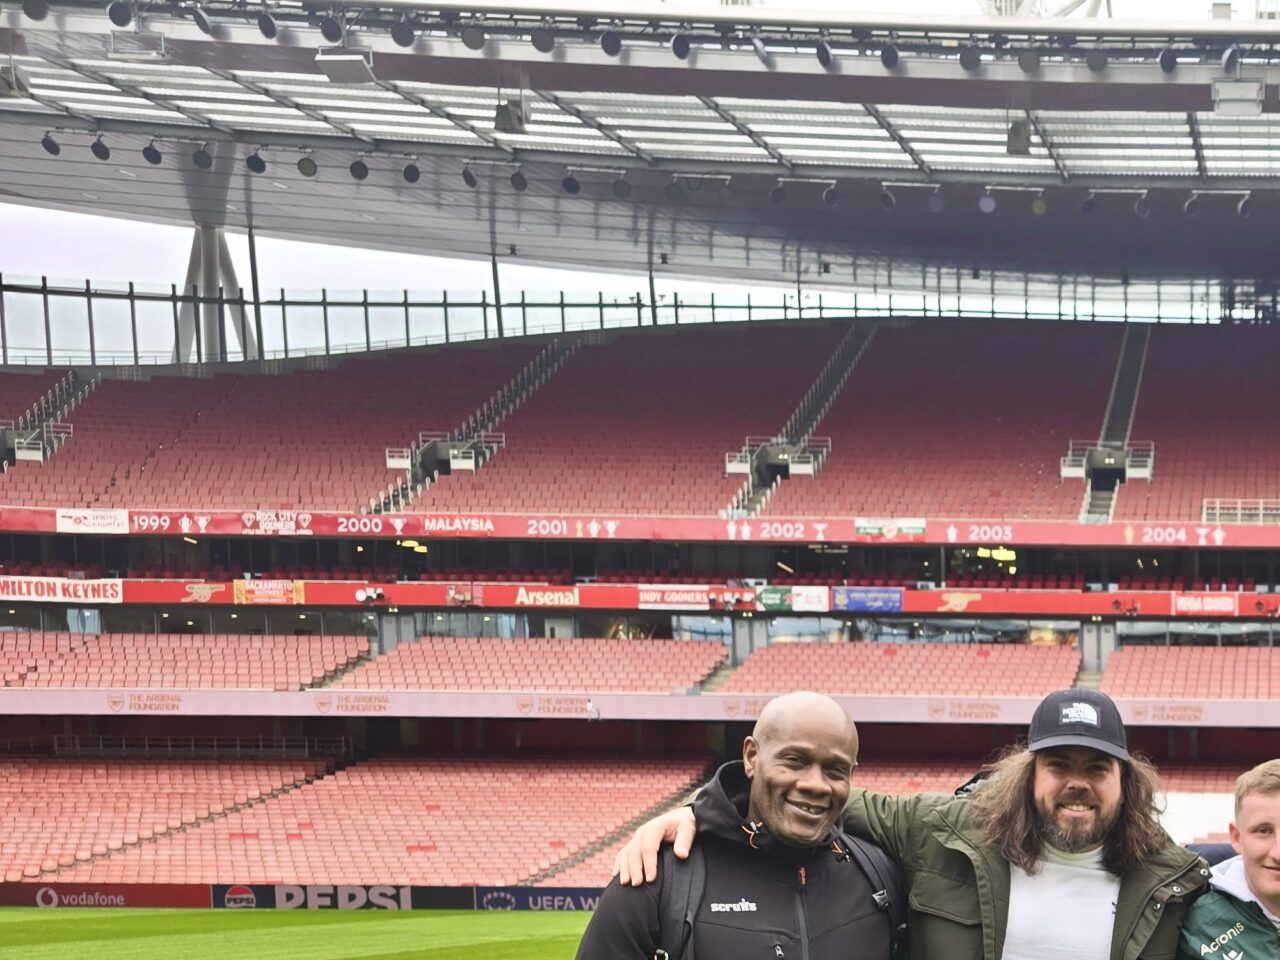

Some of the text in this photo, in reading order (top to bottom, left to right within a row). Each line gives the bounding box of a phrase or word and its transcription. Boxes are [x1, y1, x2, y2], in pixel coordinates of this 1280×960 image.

[133, 515, 170, 531] 1999
[337, 517, 383, 533] 2000
[424, 518, 494, 532] MALAYSIA
[527, 520, 568, 535] 2001
[760, 523, 805, 538] 2002
[969, 525, 1012, 541] 2003
[1142, 527, 1187, 543] 2004
[0, 580, 119, 599] MILTON KEYNES
[515, 586, 580, 606] Arsenal
[129, 694, 181, 702] THE ARSENAL
[337, 695, 389, 703] THE ARSENAL
[129, 702, 179, 711] FOUNDATION
[337, 703, 386, 712] FOUNDATION
[62, 892, 125, 906] vodafone
[275, 886, 412, 910] PEPSI
[528, 895, 577, 910] UEFA
[1200, 921, 1245, 957] Acronis
